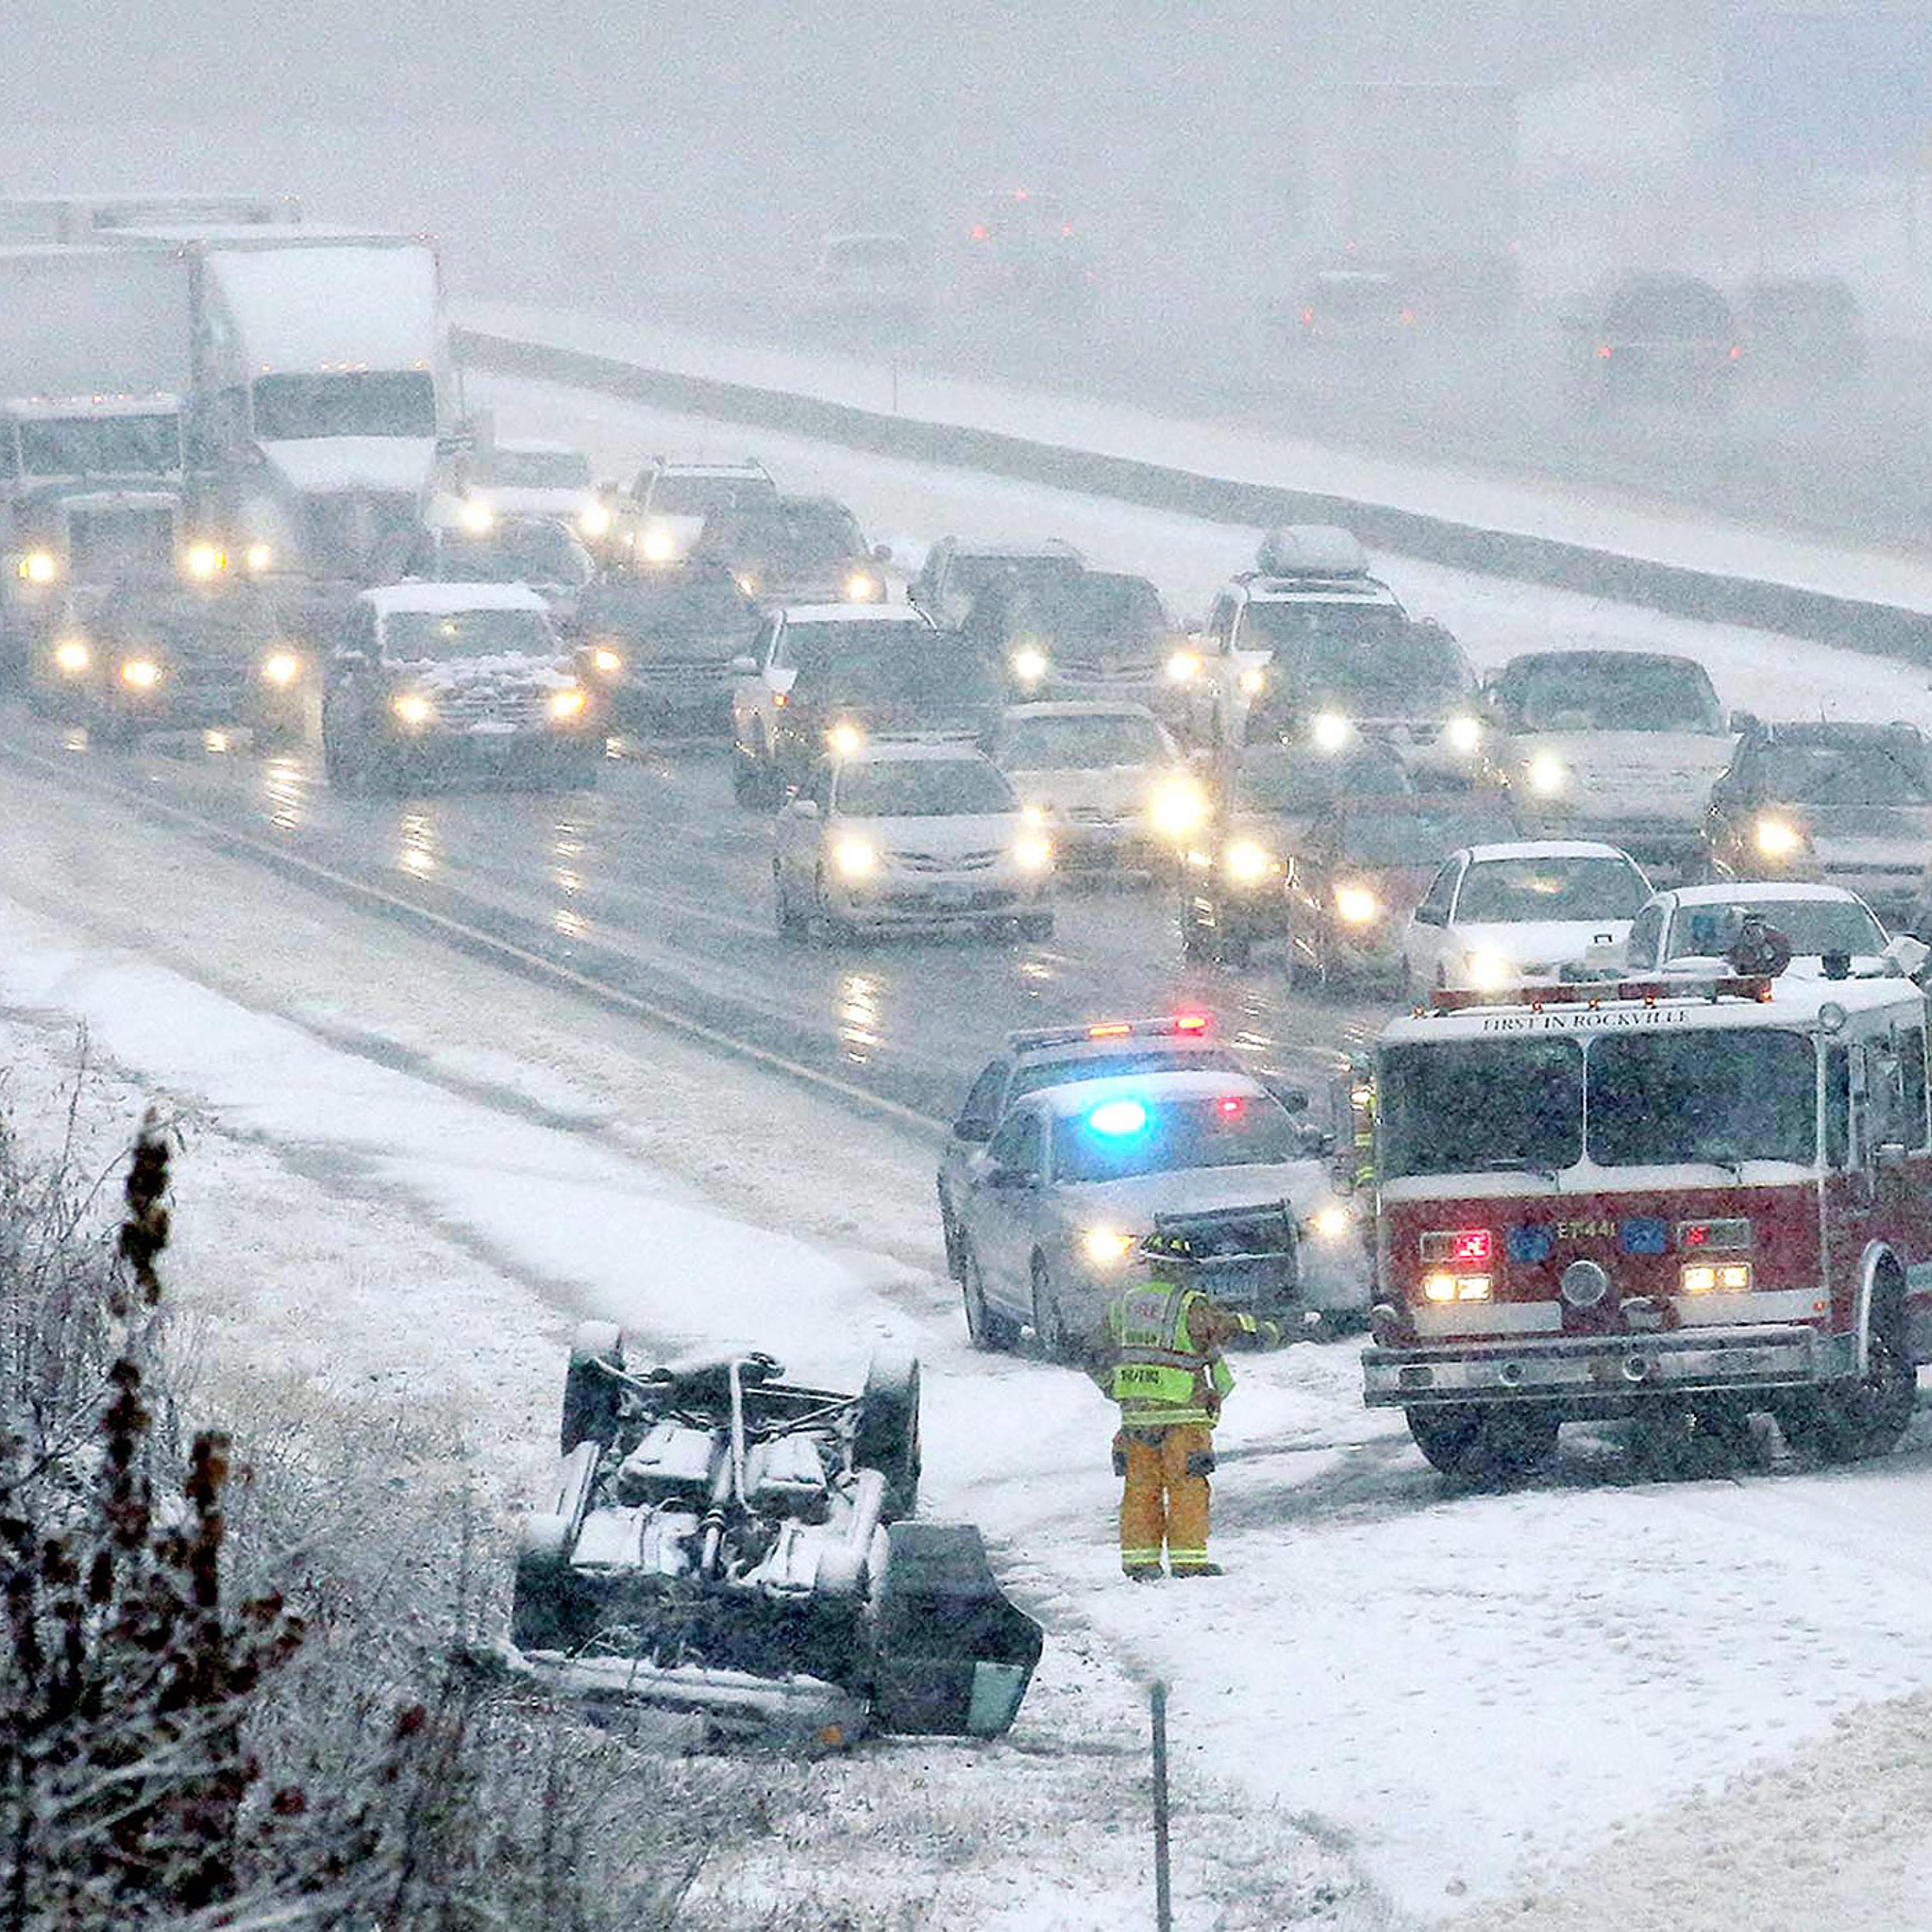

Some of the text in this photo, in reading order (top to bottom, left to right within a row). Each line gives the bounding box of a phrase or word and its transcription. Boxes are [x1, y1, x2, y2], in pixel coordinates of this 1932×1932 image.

[1483, 1010, 1690, 1031] FIRST IN ROCKVILLE
